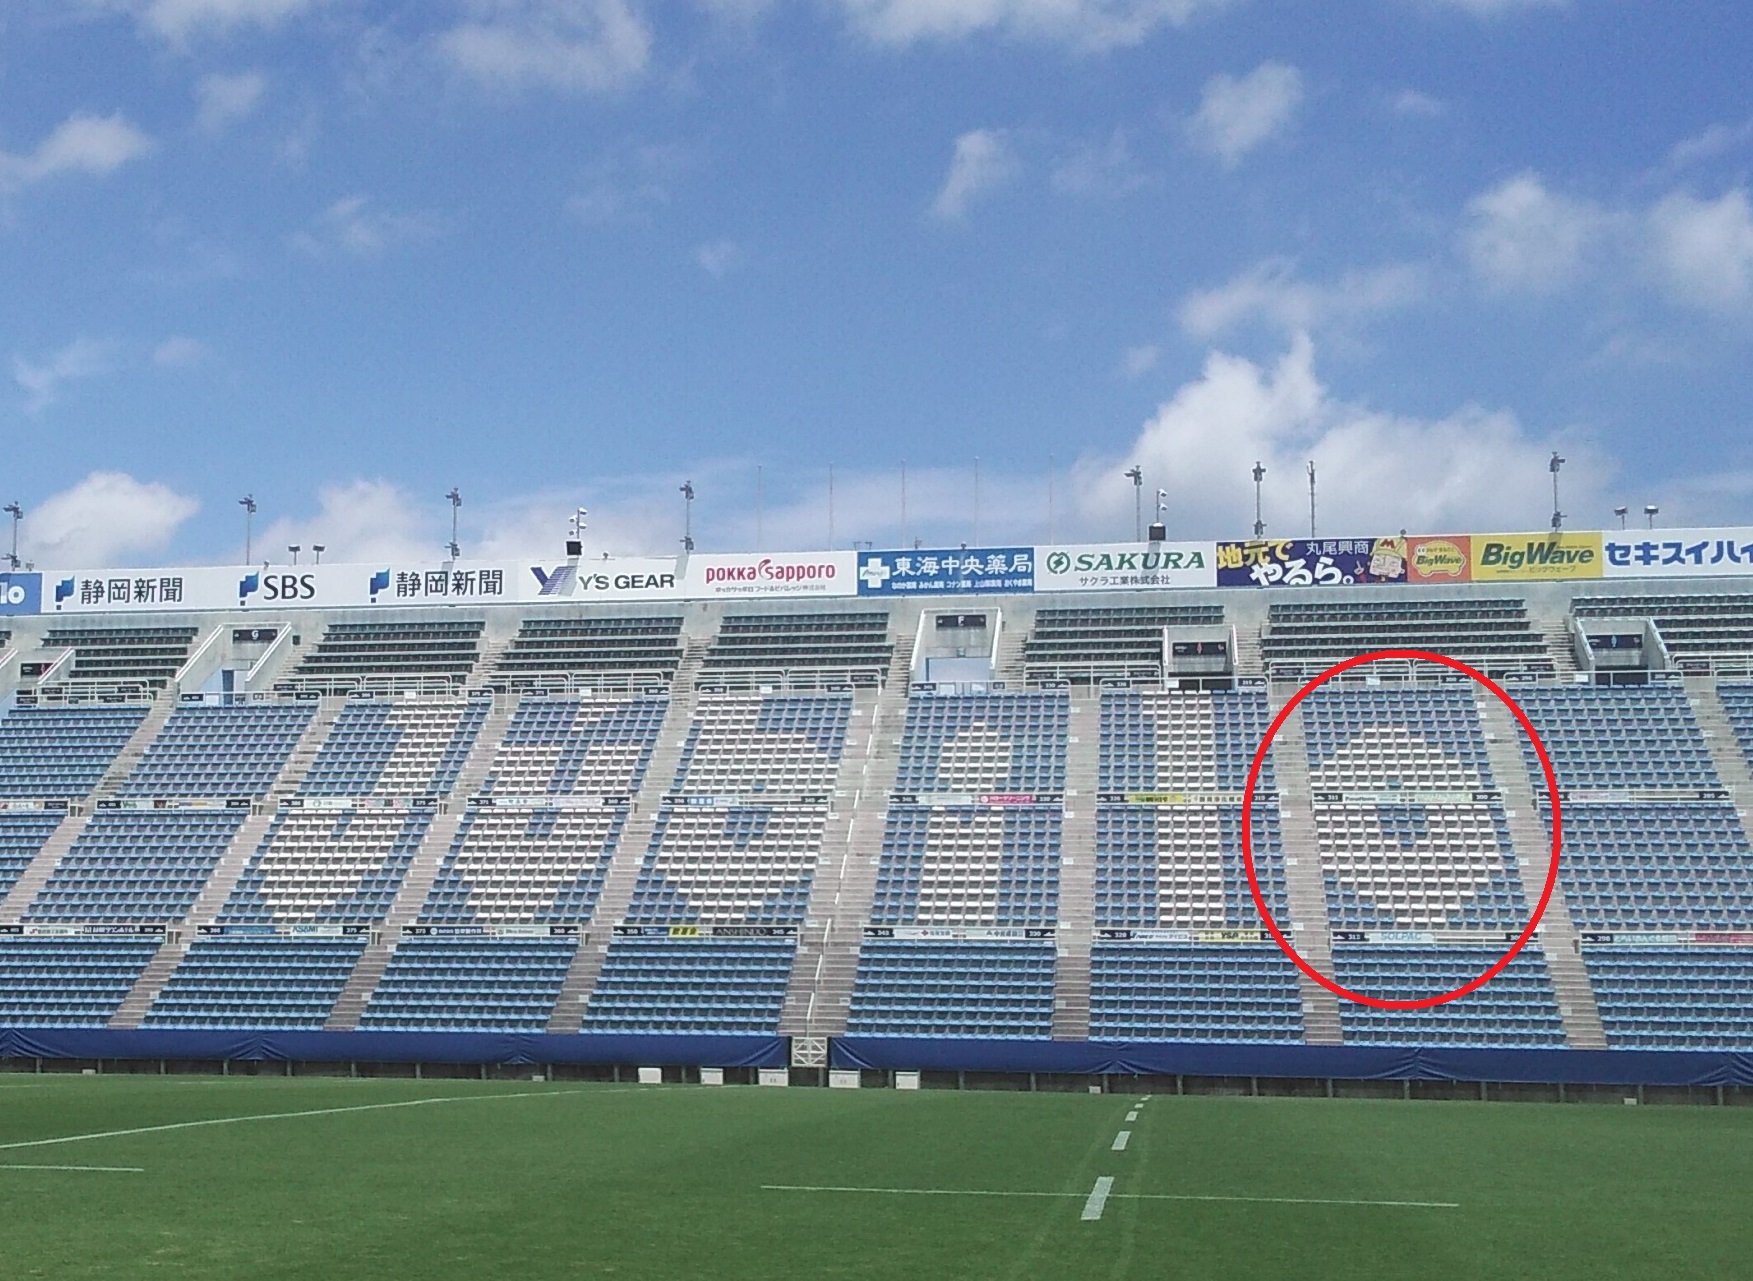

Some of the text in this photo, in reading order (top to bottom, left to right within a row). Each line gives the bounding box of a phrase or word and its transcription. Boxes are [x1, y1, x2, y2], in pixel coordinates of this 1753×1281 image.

[1217, 540, 1293, 569] 地元で
[1306, 540, 1369, 556] 丸尾興商
[1480, 541, 1595, 570] BigWave
[892, 553, 1032, 577] 東海中央薬局
[1074, 551, 1205, 571] SAKURA
[1250, 556, 1354, 586] やるら。
[1416, 554, 1462, 567] BigWave
[80, 577, 183, 604] 静岡新聞
[264, 574, 315, 599] SBS
[396, 569, 503, 597] 静岡新聞
[578, 573, 675, 590] Y'S GEAR
[1080, 574, 1171, 586] サクラ工業株式会社
